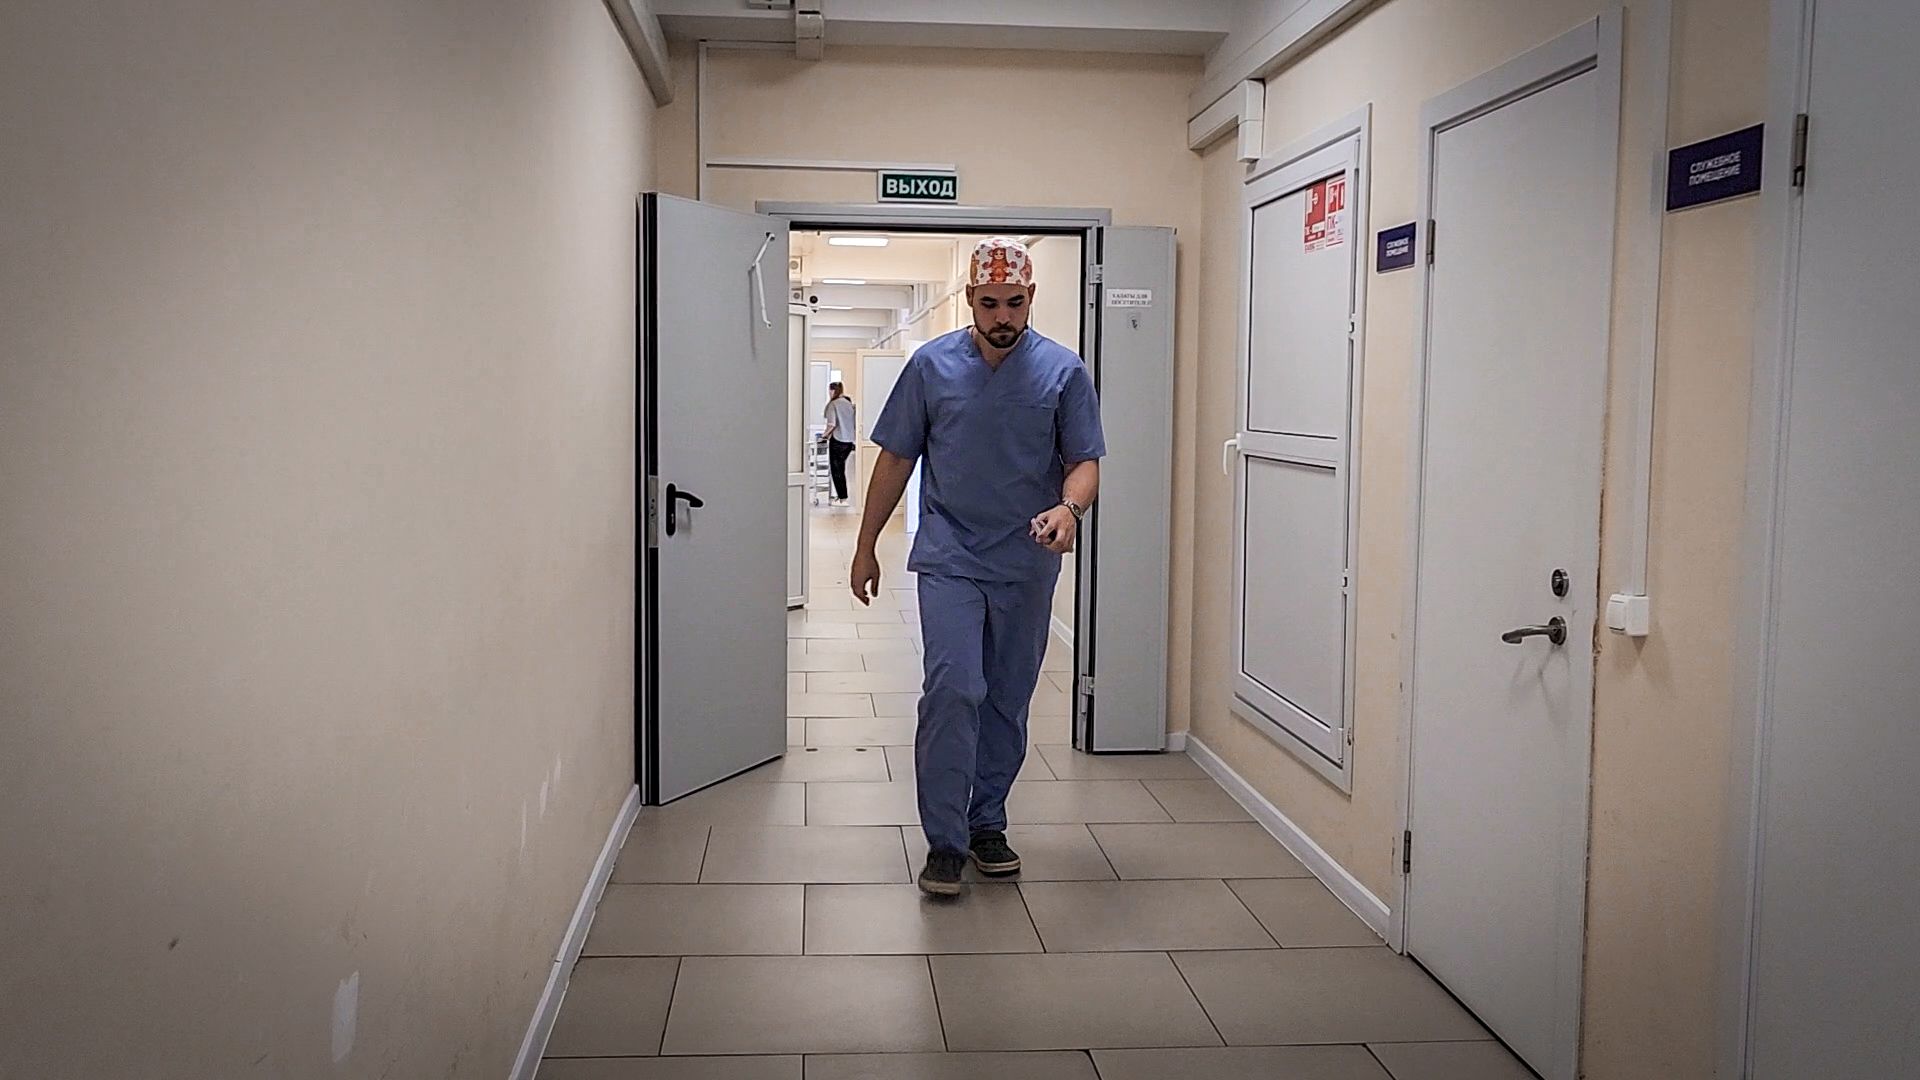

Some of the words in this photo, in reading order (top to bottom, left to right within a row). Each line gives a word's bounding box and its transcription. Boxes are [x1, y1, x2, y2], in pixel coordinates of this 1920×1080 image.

[1690, 151, 1741, 174] СЛУЖЕБНОЕ
[1688, 163, 1741, 186] ПОМЕЩЕНИЕ
[886, 178, 954, 197] ВЫХОД
